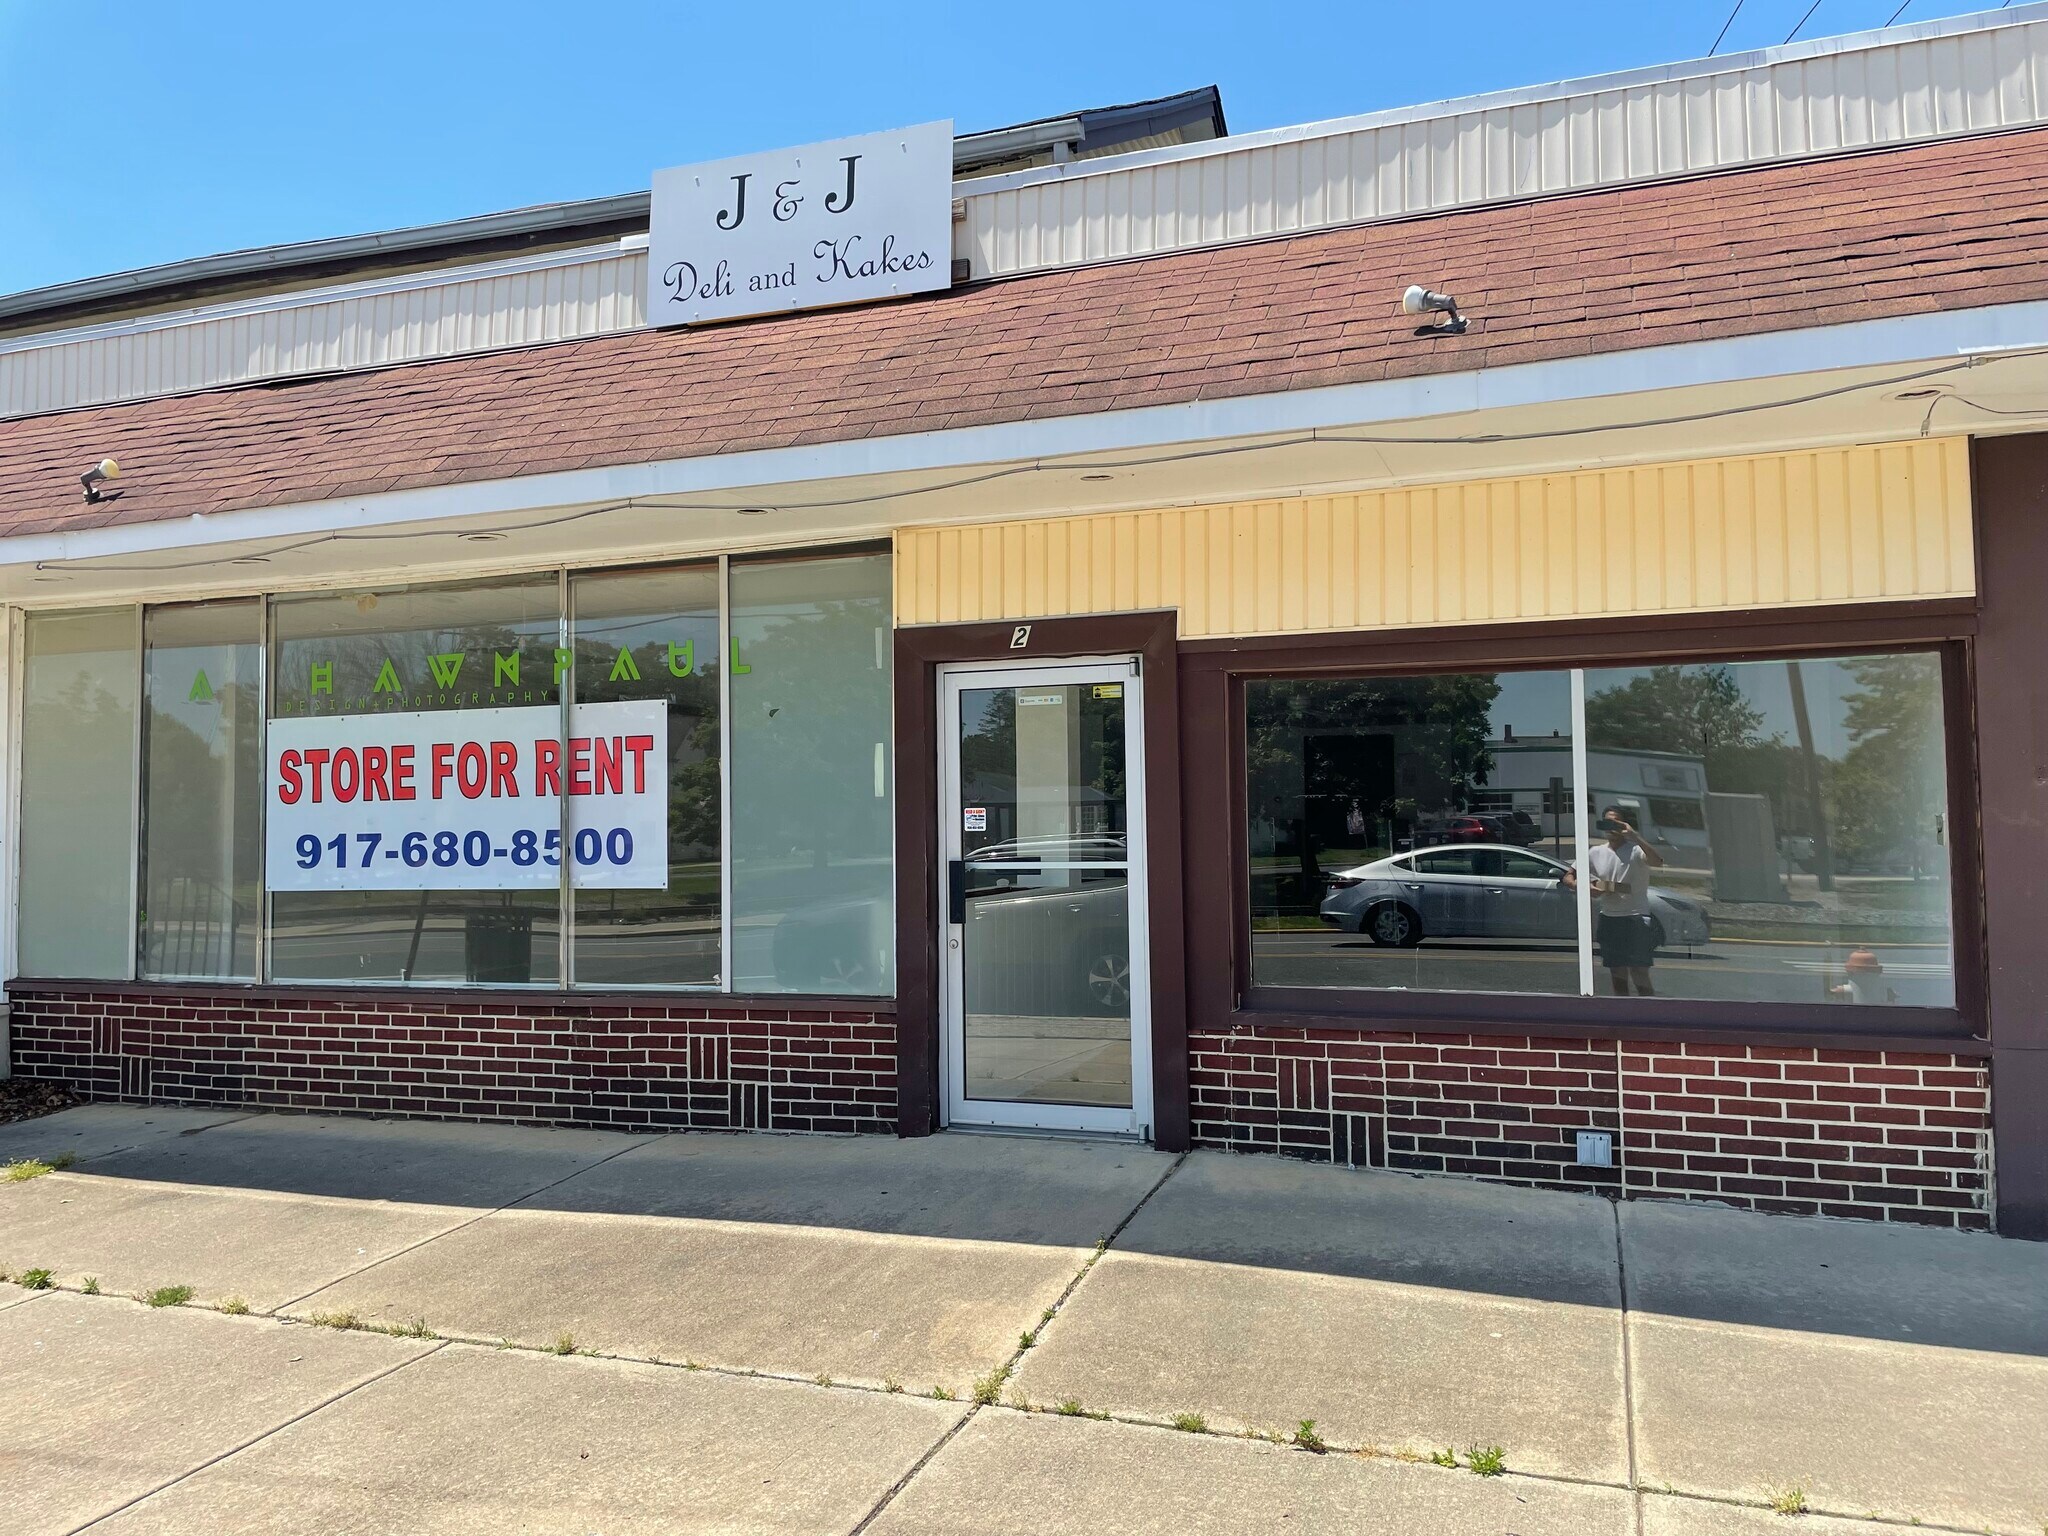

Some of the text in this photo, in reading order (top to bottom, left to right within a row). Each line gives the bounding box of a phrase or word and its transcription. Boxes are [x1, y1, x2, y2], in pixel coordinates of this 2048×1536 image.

[716, 154, 862, 230] J & J
[663, 234, 934, 303] Deli and Kakes
[1012, 627, 1027, 646] 2
[278, 735, 654, 805] STORE FOR RENT
[295, 826, 634, 870] 917-680-8500
